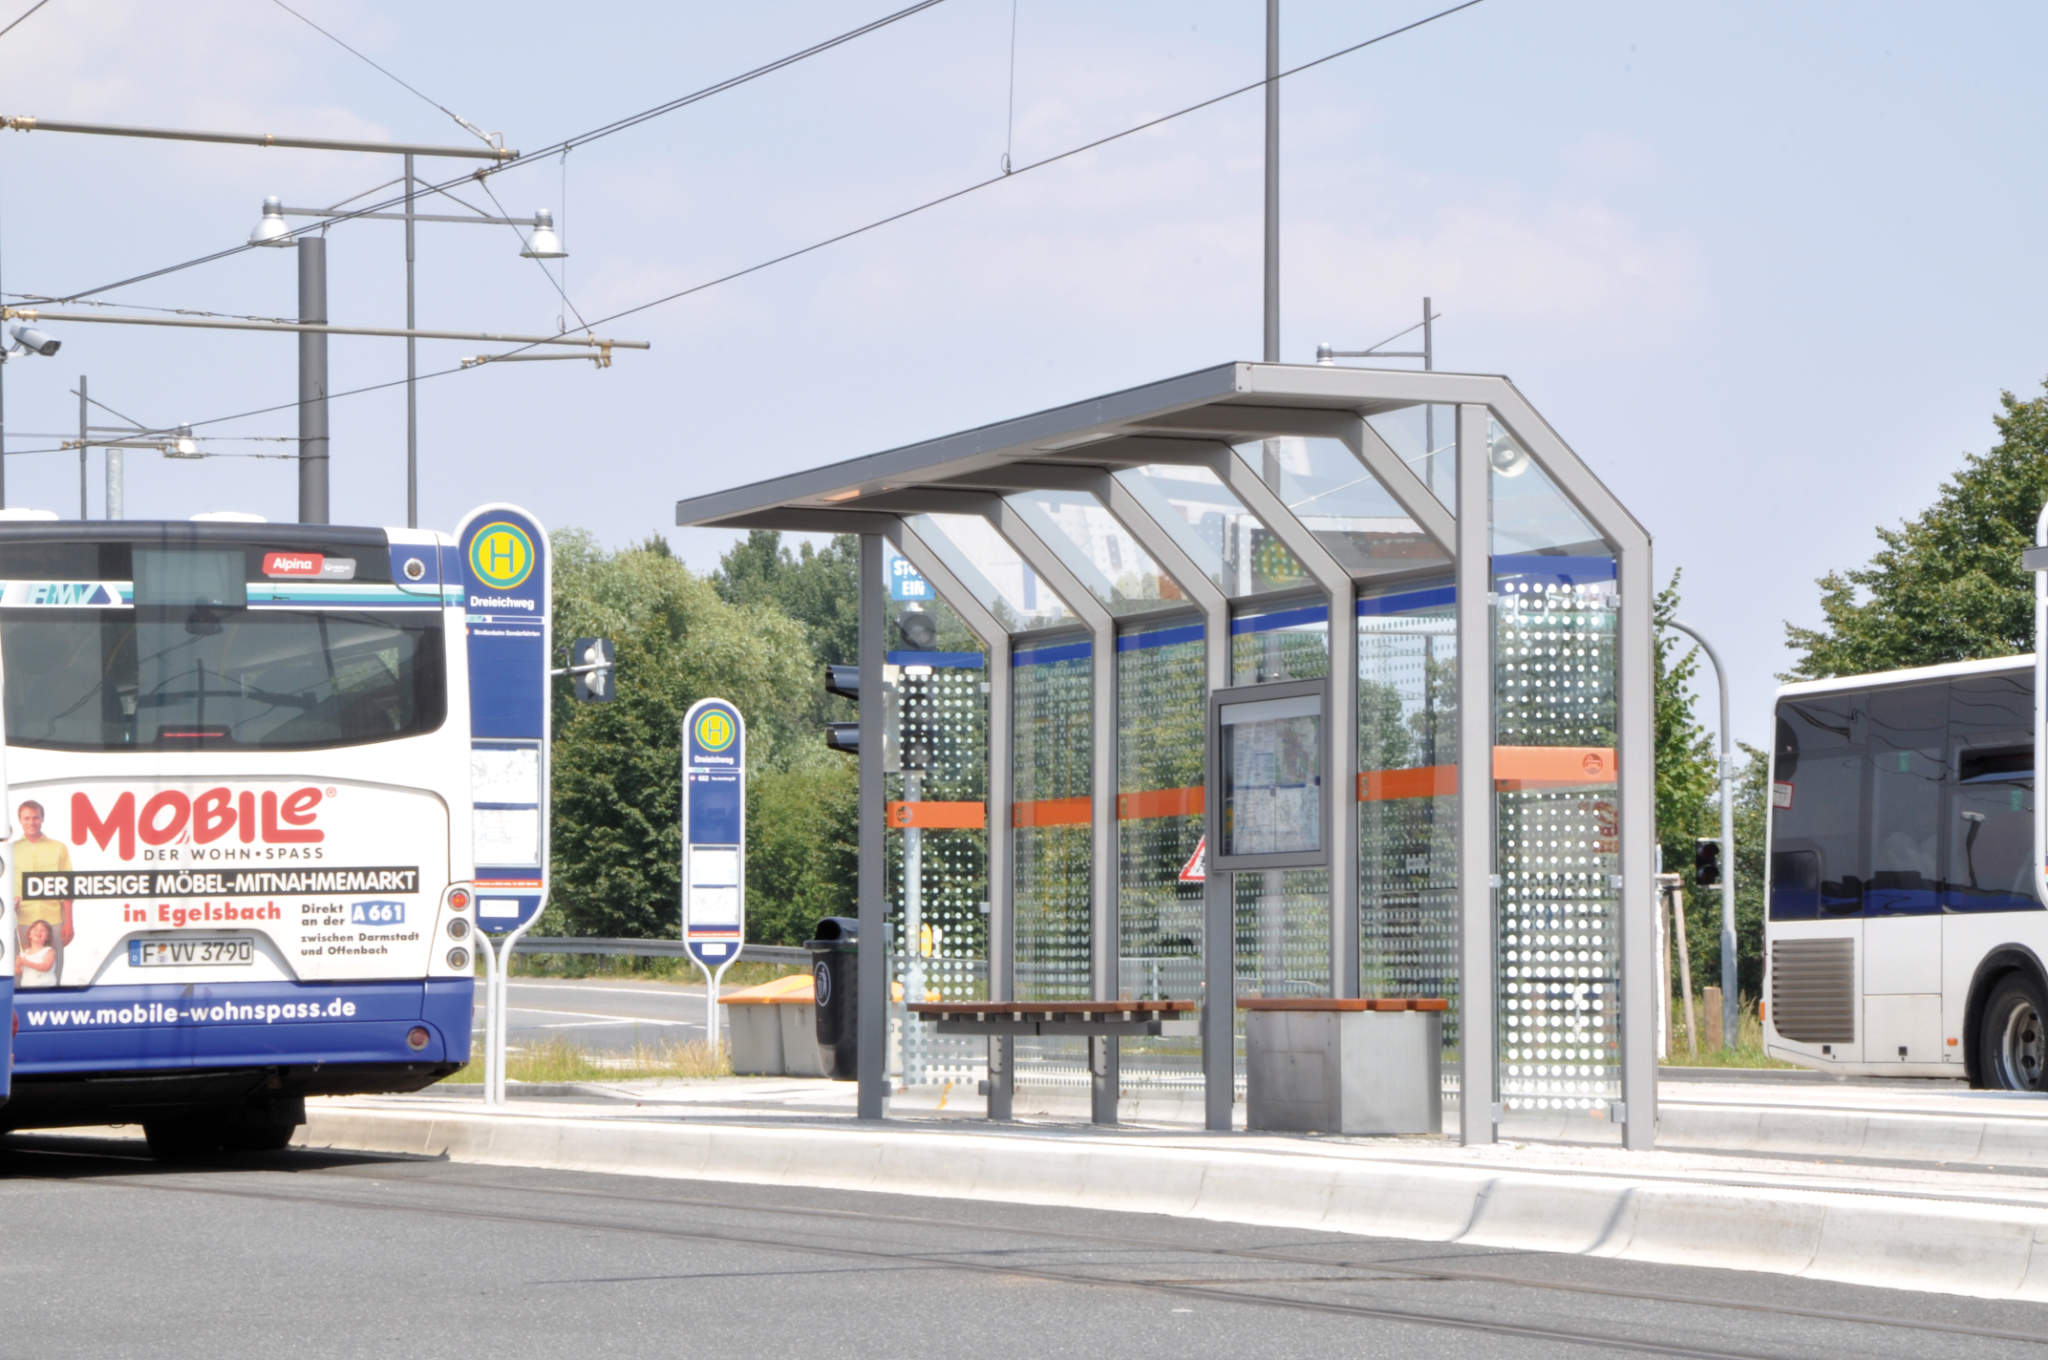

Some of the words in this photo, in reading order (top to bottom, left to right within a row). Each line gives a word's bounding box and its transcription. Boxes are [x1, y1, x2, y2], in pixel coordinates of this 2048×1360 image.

[273, 557, 312, 572] Alpina
[470, 595, 535, 611] Dreieichweg
[144, 849, 179, 861] DER
[27, 876, 68, 896] DER
[74, 875, 149, 895] RIESIGE
[155, 870, 416, 894] MÖBEL-MITNAHMEMARKT
[124, 904, 147, 922] in
[158, 901, 281, 927] Egelsbach
[301, 904, 344, 914] Direkt
[353, 905, 366, 921] A
[368, 904, 402, 921] 661
[301, 917, 318, 926] an
[323, 916, 345, 926] der
[301, 933, 353, 942] zwischen
[358, 932, 420, 942] Darmstadt
[143, 943, 155, 962] F
[170, 943, 196, 961] VV
[200, 941, 250, 961] 3790
[301, 947, 323, 956] und
[327, 946, 388, 955] Offenbach
[27, 997, 356, 1026] www.mobile-wohnspass.de
